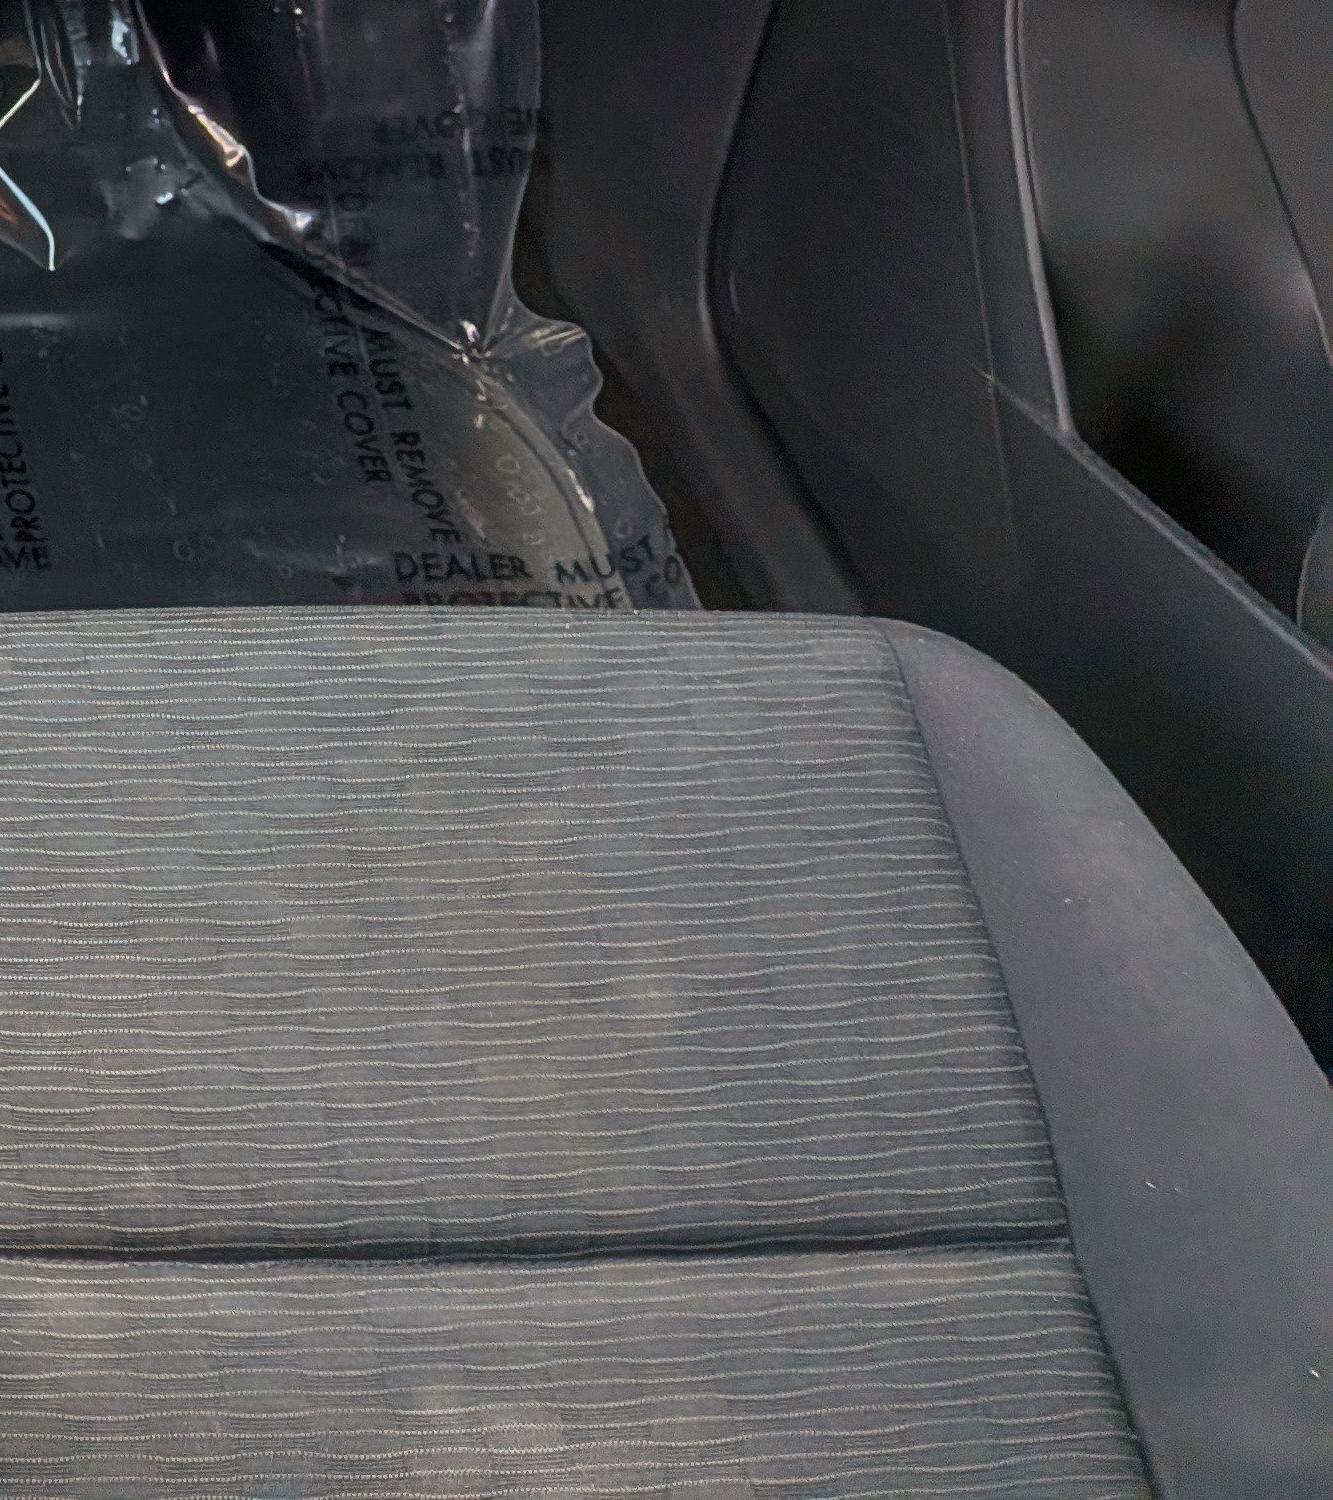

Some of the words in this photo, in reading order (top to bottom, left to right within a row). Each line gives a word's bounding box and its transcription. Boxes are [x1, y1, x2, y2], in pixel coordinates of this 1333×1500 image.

[337, 389, 393, 484] COVER
[389, 429, 462, 545] REMOVE
[393, 552, 533, 583] DEALER
[555, 534, 656, 583] MUST
